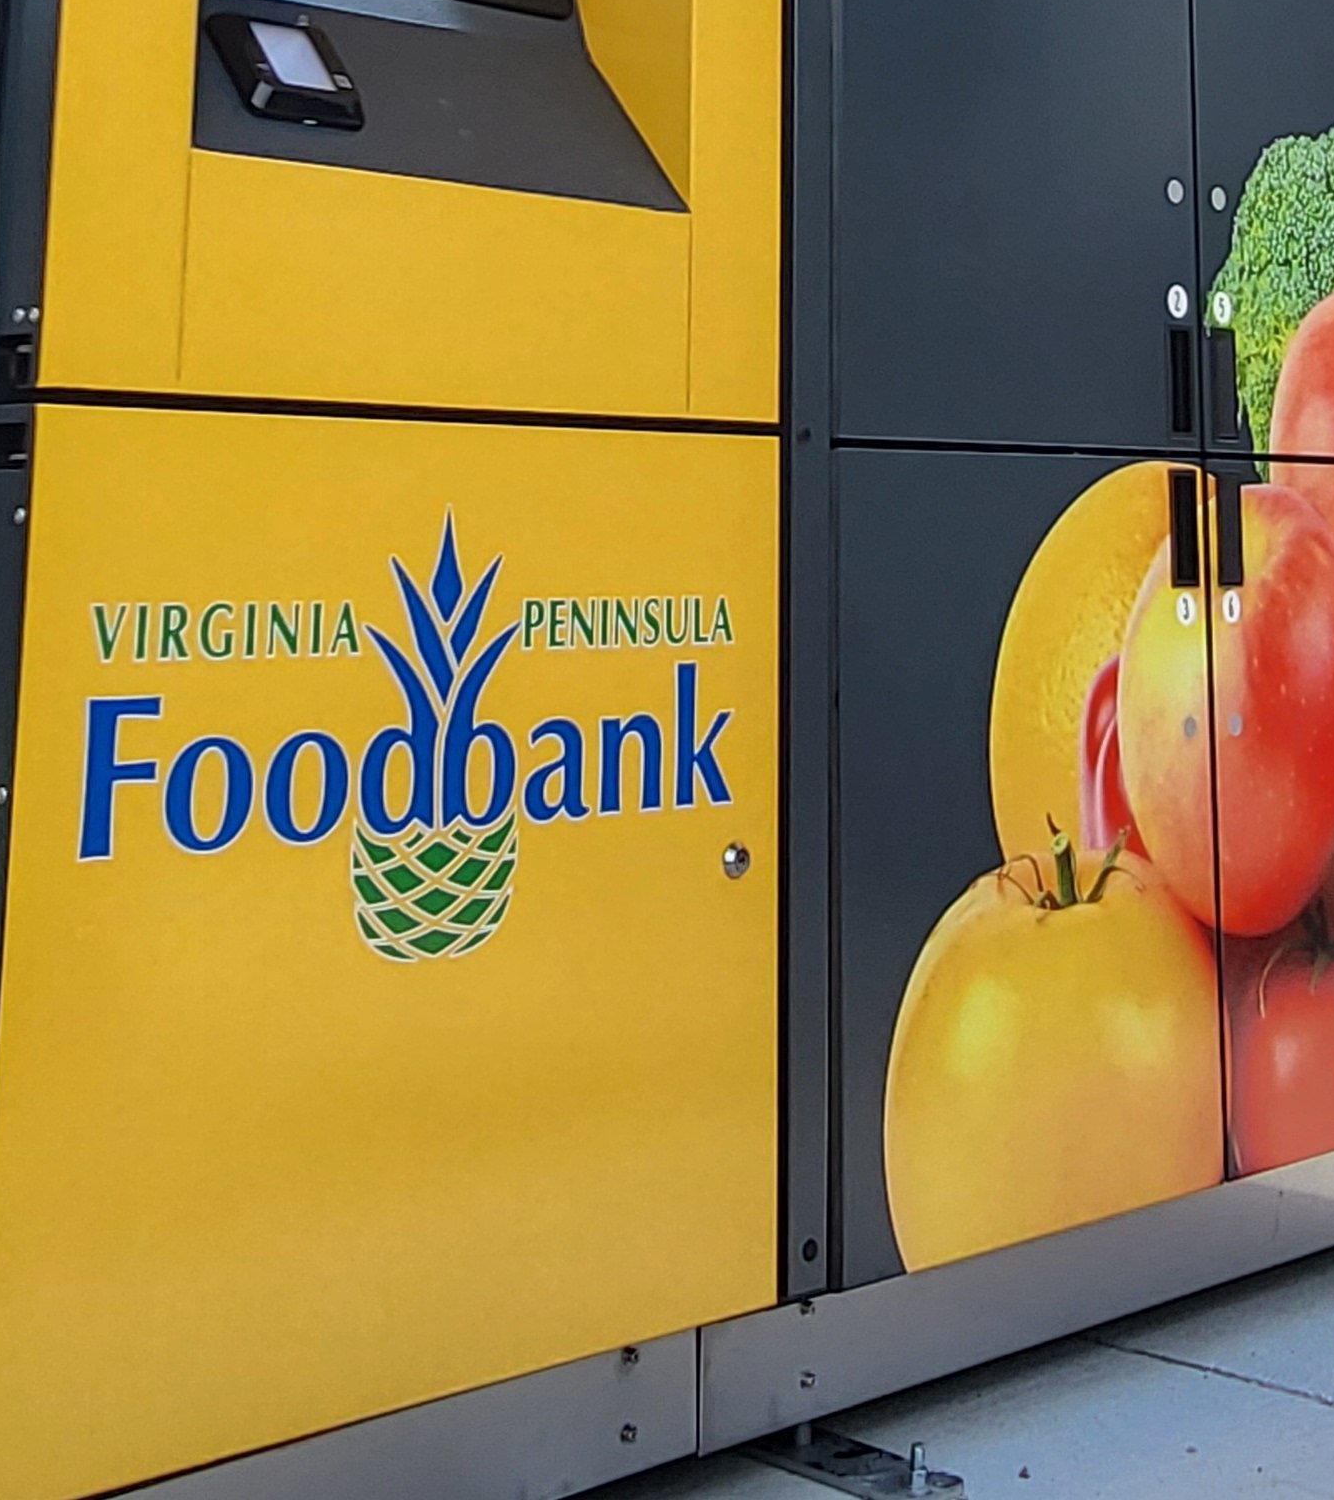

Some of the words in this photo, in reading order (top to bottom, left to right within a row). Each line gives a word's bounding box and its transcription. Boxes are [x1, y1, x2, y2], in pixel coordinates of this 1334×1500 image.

[91, 601, 363, 662] VIRGINIA
[521, 596, 734, 649] PENINSULA
[77, 640, 734, 861] Foodbank
